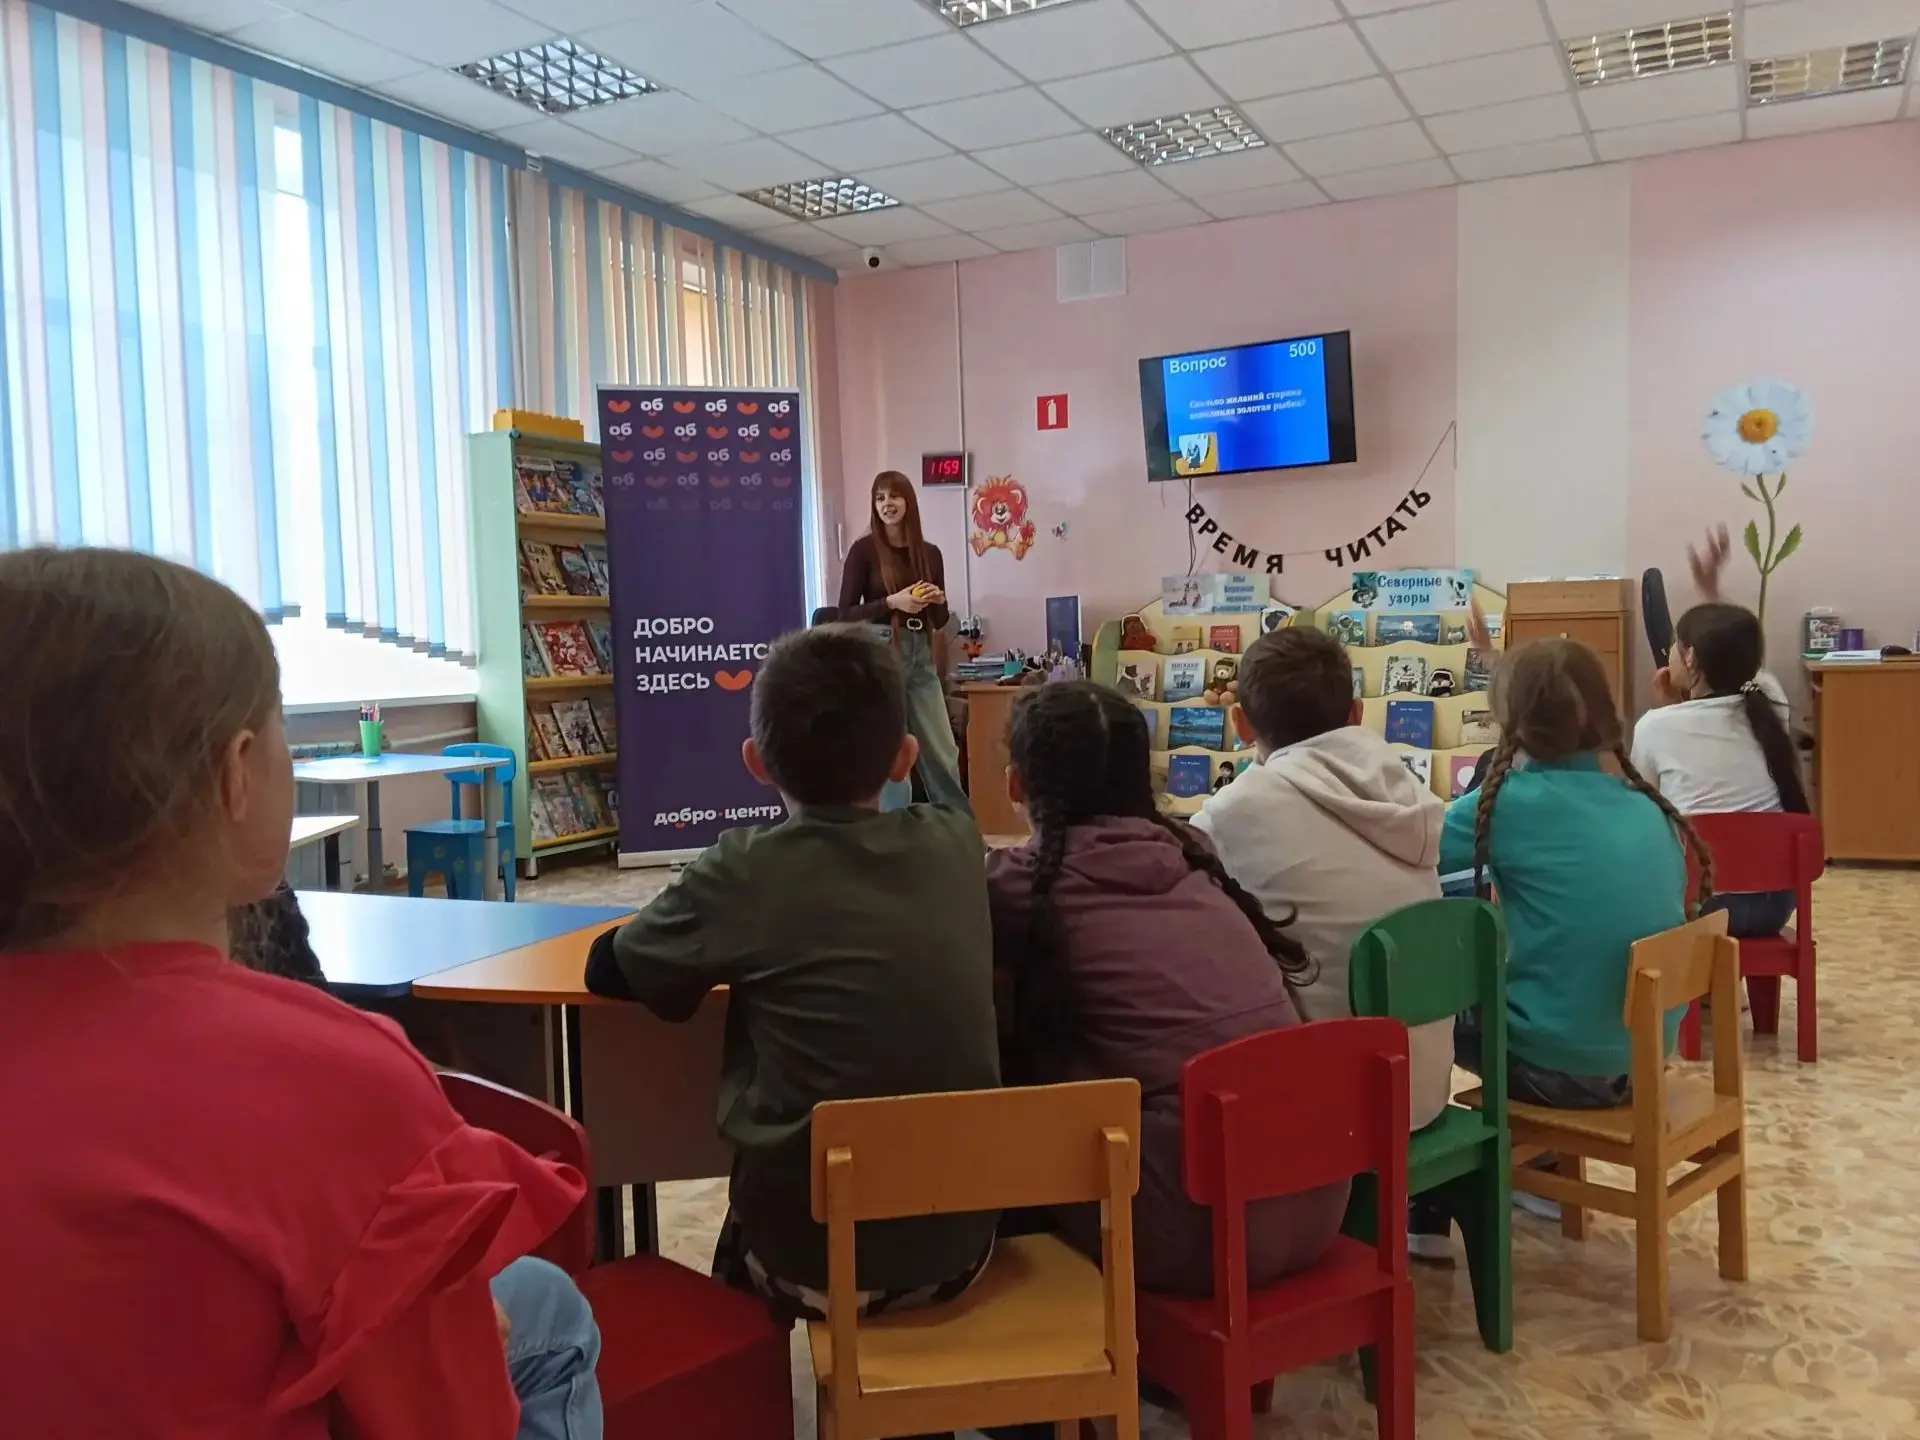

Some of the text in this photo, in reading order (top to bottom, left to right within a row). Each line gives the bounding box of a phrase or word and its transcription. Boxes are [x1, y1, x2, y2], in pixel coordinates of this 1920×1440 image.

[1169, 341, 1316, 375] Вопрос 500
[1226, 391, 1264, 404] желаний
[1237, 404, 1271, 414] золотая
[1185, 489, 1431, 574] ВРЕМЯ ЧИТАТЬ
[1377, 575, 1442, 589] Северные
[1388, 593, 1430, 607] узоры
[633, 617, 714, 639] ДОБРО
[635, 643, 774, 664] НАЧИНАЕТС
[636, 673, 710, 694] ЗДЕСЬ
